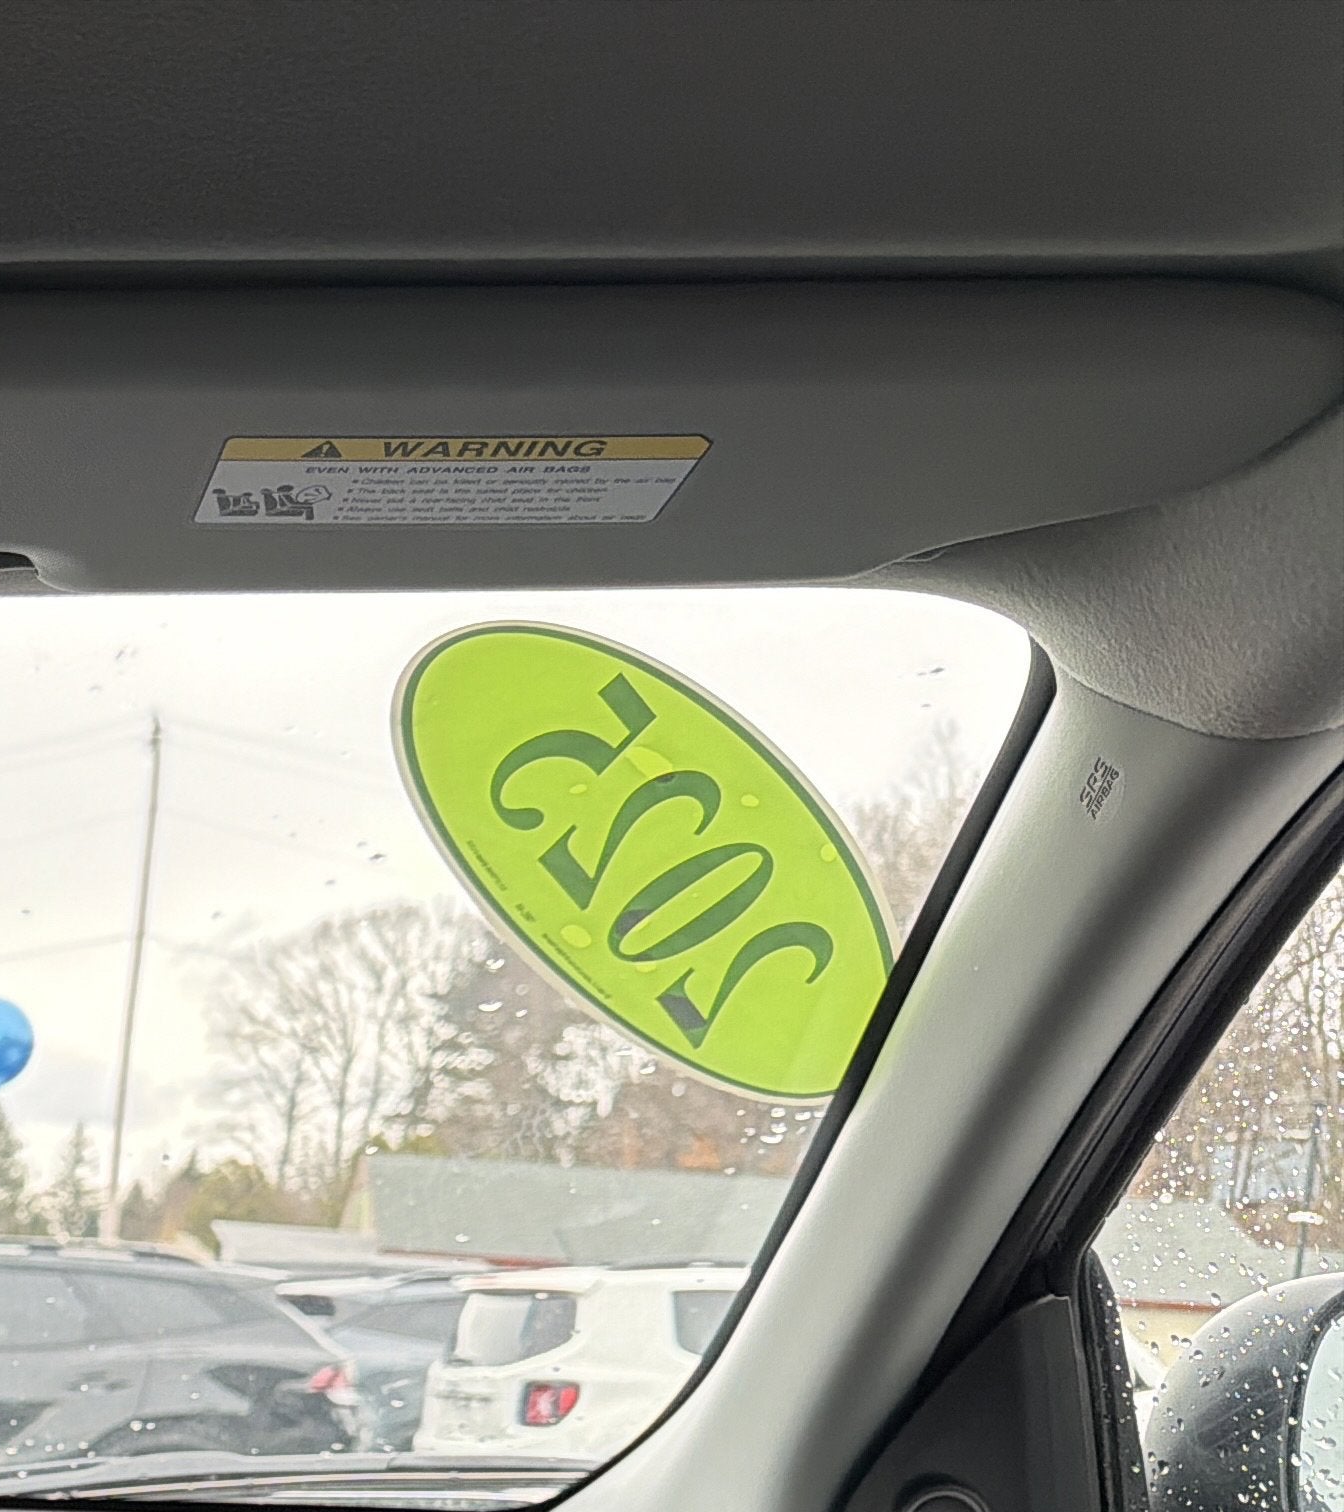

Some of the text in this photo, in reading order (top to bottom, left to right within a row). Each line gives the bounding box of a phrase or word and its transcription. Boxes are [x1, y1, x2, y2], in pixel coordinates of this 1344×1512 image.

[382, 439, 608, 459] WARNING
[306, 465, 592, 475] EVEN WITH ADVANCED AIR BAGS
[1079, 757, 1108, 809] SRS
[1090, 767, 1120, 820] AIRBAG
